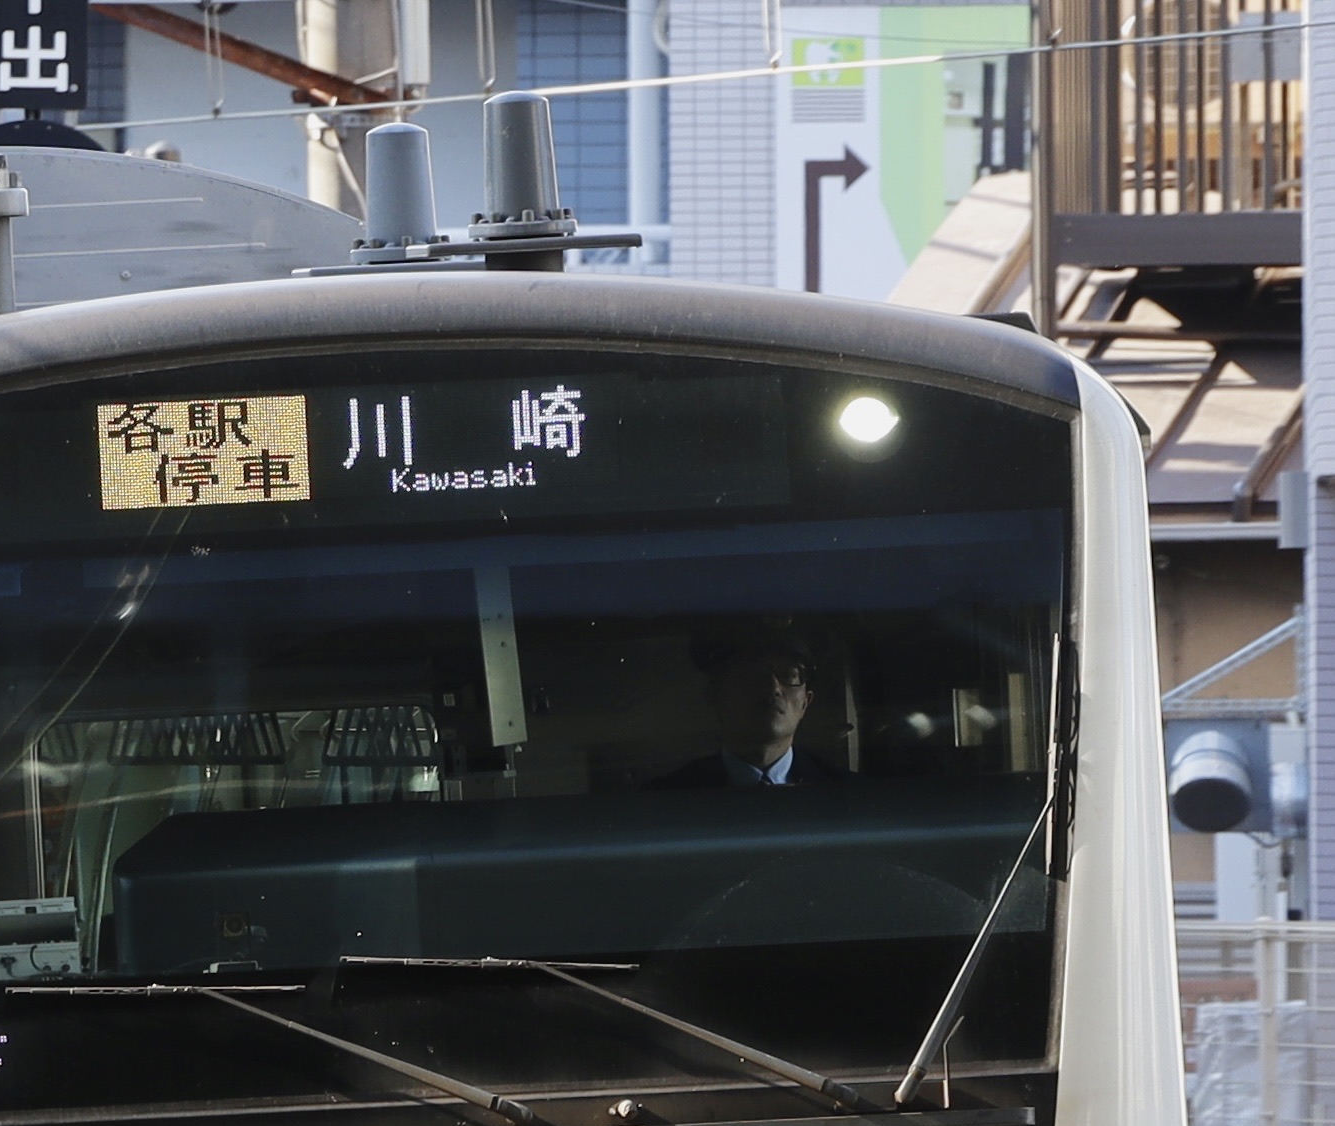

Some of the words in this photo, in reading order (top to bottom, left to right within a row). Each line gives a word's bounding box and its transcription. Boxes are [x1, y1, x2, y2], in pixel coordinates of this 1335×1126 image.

[108, 401, 252, 454] 各駅
[153, 449, 300, 503] 停車
[391, 461, 538, 493] Kawasaki
